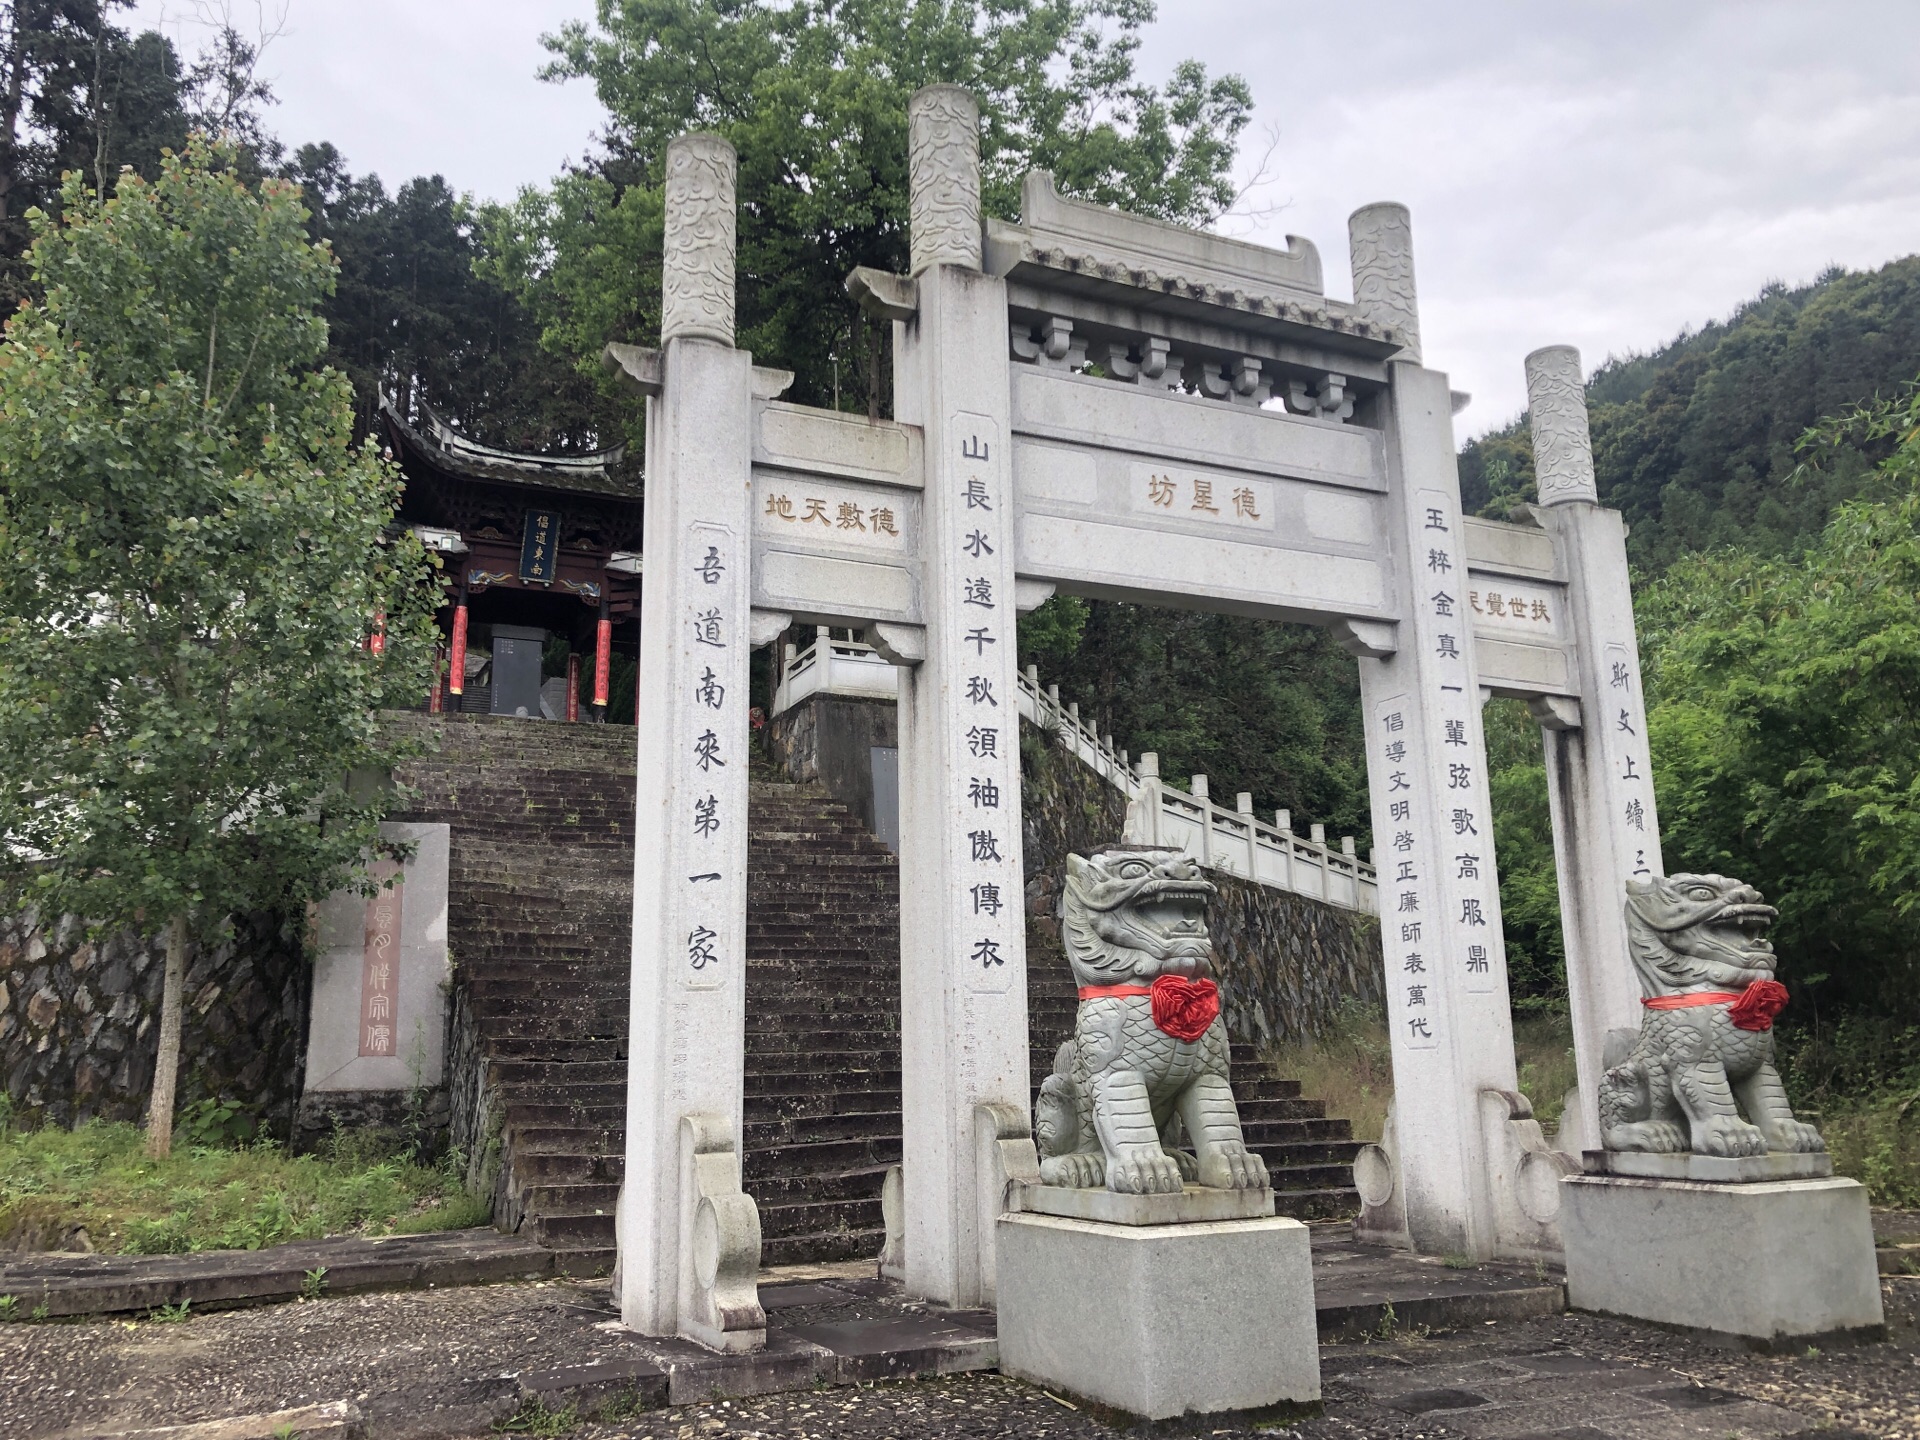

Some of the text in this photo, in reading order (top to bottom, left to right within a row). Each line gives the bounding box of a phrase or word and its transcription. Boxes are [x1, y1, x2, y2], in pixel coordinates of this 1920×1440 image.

[1148, 474, 1261, 521] 德星坊
[687, 546, 727, 969] 吾道南來第一家
